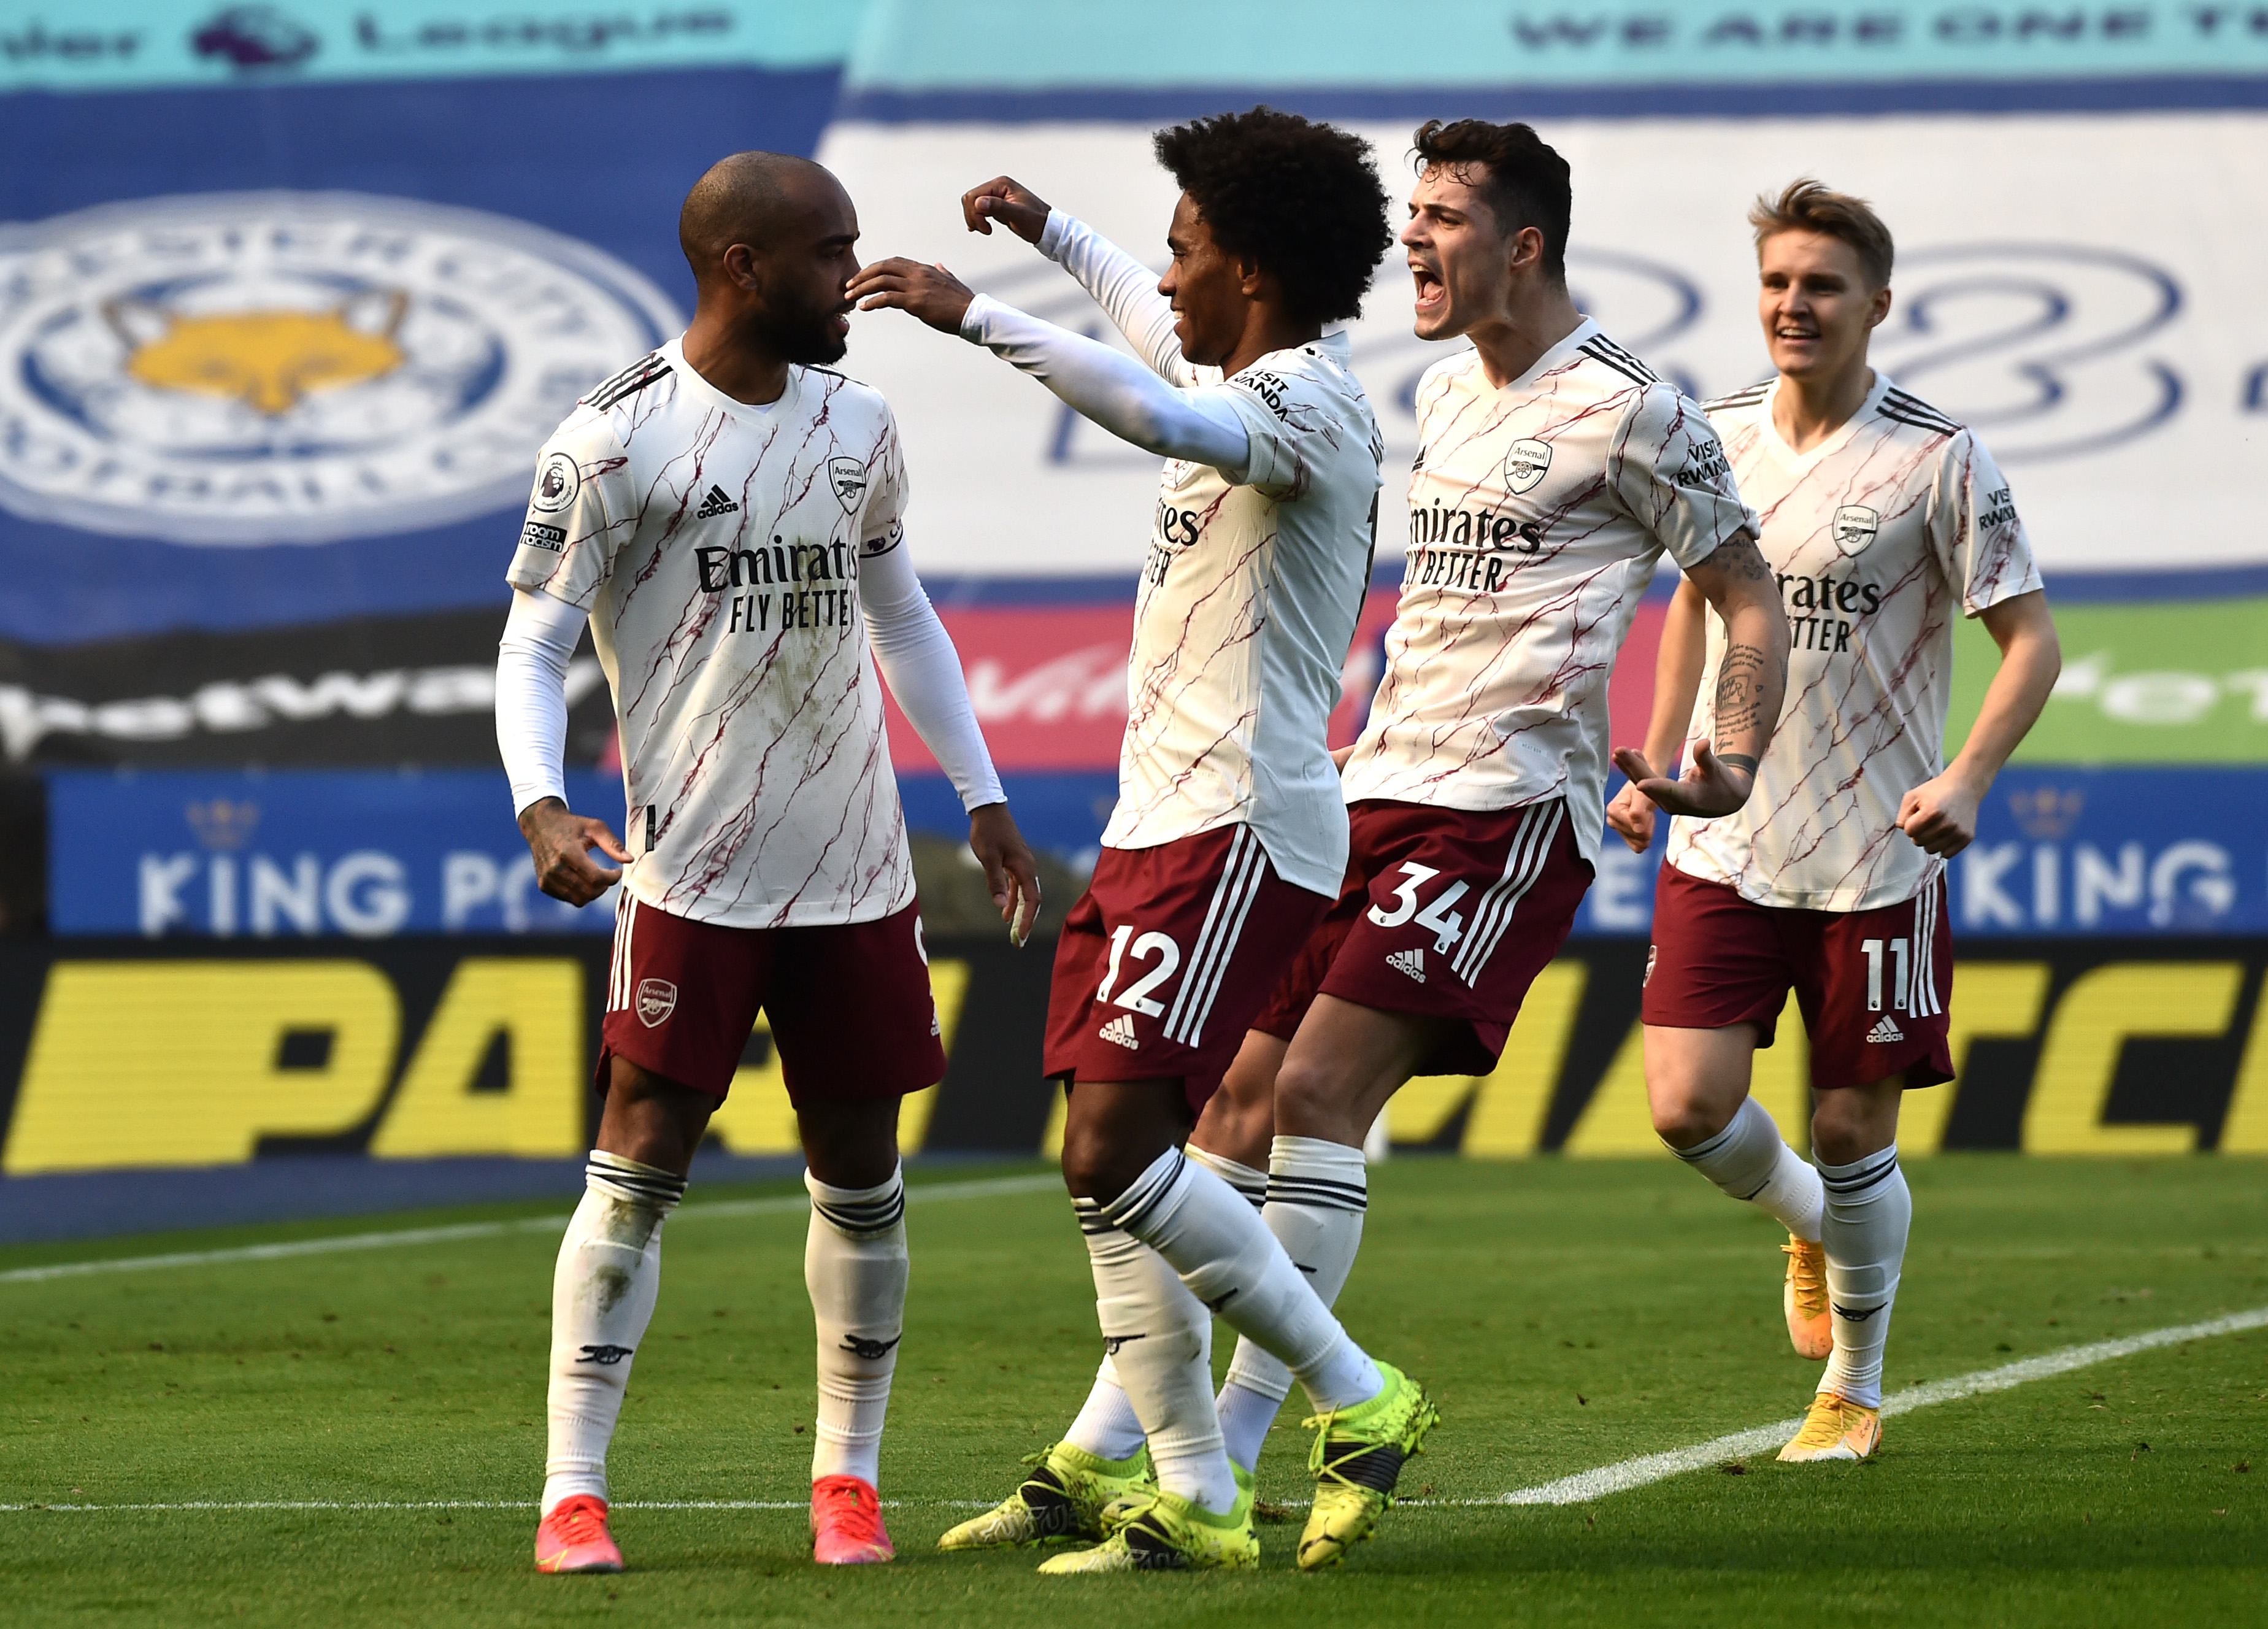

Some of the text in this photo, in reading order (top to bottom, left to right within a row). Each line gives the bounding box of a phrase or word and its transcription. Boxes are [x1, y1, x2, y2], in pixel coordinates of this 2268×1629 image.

[1509, 12, 1675, 52] WE
[1703, 12, 1905, 50] ARE
[1932, 9, 2156, 49] ONE
[1513, 447, 1545, 460] Arsenal
[834, 466, 861, 477] Arsenal
[1987, 488, 2010, 506] VIS
[697, 502, 739, 520] adidas
[1840, 514, 1872, 524] Arsenal
[525, 523, 561, 541] room
[1410, 497, 1540, 553] mirates
[521, 534, 563, 552] racism
[1421, 550, 1503, 593] BETTER
[730, 594, 771, 633] FLY
[137, 849, 413, 939] KING
[1966, 839, 2237, 929] KING
[1367, 861, 1470, 956] 34
[1096, 925, 1180, 1019] 12
[1385, 955, 1426, 984] adidas
[1861, 938, 1909, 1011] 11
[643, 985, 672, 998] Arsenal
[1099, 1027, 1140, 1050] adidas
[1866, 1032, 1904, 1043] adidas
